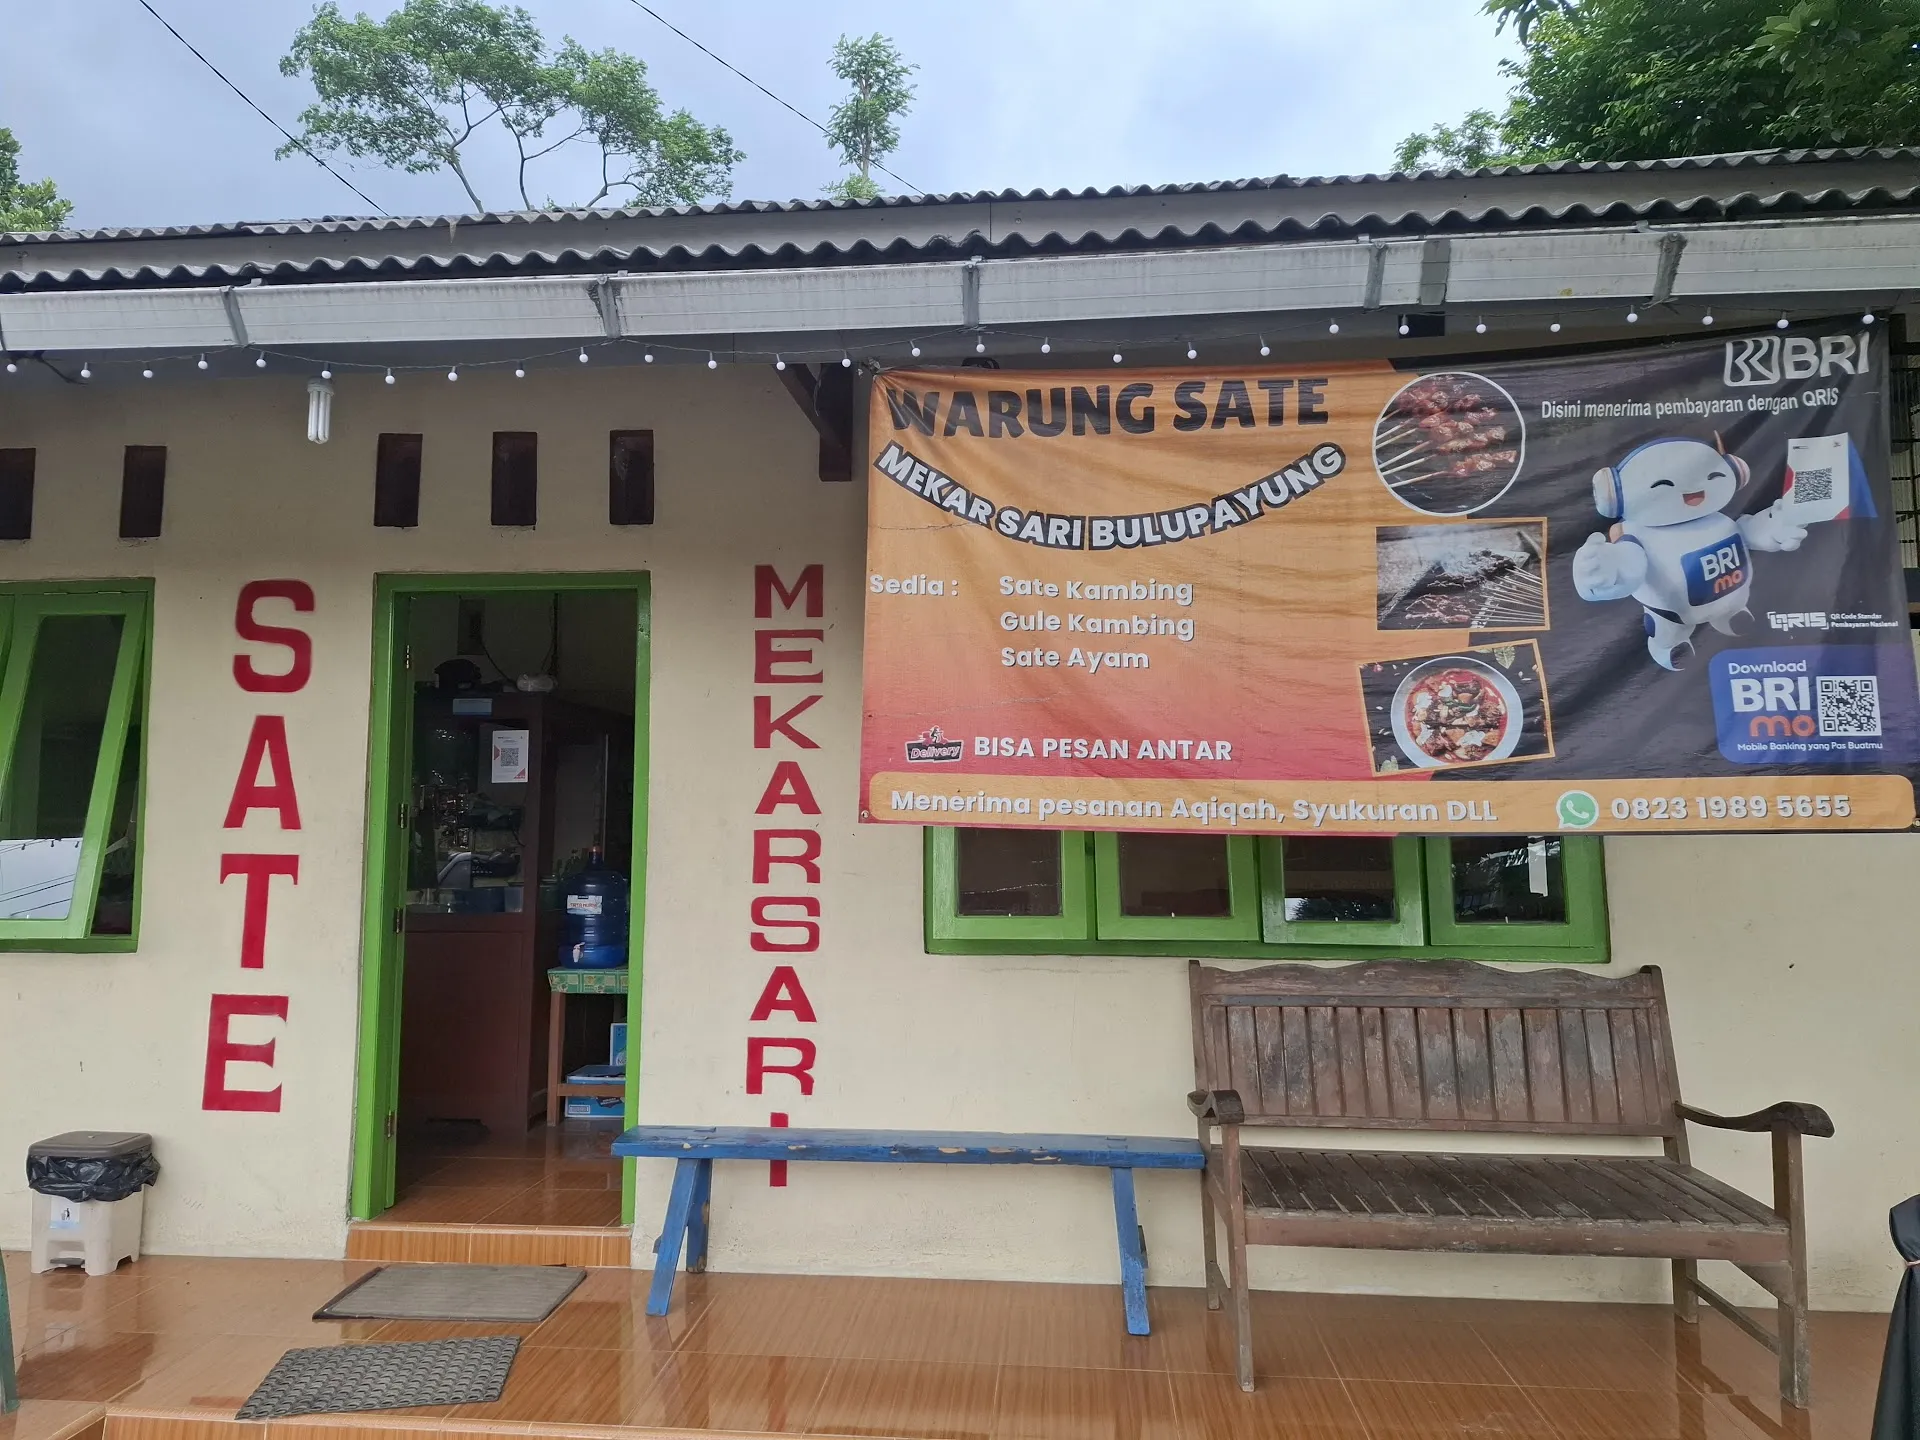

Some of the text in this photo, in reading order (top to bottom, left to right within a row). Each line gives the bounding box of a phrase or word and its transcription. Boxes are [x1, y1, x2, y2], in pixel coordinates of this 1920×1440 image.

[1784, 332, 1870, 381] BRI
[886, 378, 1329, 438] WARUNG SATE
[1541, 387, 1839, 419] Disini menerima pembayaran dengan QRIS
[878, 445, 1344, 547] MEKAR SARI BULUPAYUNG
[1700, 543, 1741, 582] BRI
[870, 574, 945, 597] Sedia
[1000, 575, 1194, 606] Sate Kambing
[1714, 569, 1744, 594] mo
[1000, 611, 1195, 641] Gule Kambing
[1768, 611, 1829, 632] QRIS
[1831, 620, 1899, 629] Pembayaran Nasional
[1857, 612, 1882, 620] Standar
[1001, 647, 1150, 674] Sate Ayam
[1728, 660, 1807, 675] Download
[1730, 676, 1811, 713] BRI
[1750, 714, 1817, 737] mo
[910, 745, 961, 759] Delivery
[974, 737, 1233, 762] BISA PESAN ANTAR
[1737, 741, 1883, 752] Mobile Banking yang Pas Buatmu
[891, 790, 1499, 827] Menerima pesanan Aqiqah, Syukuran DLL
[1611, 795, 1851, 820] 0823 1989 5655
[201, 578, 316, 1113] SATE
[745, 564, 824, 1188] MEKARSARI
